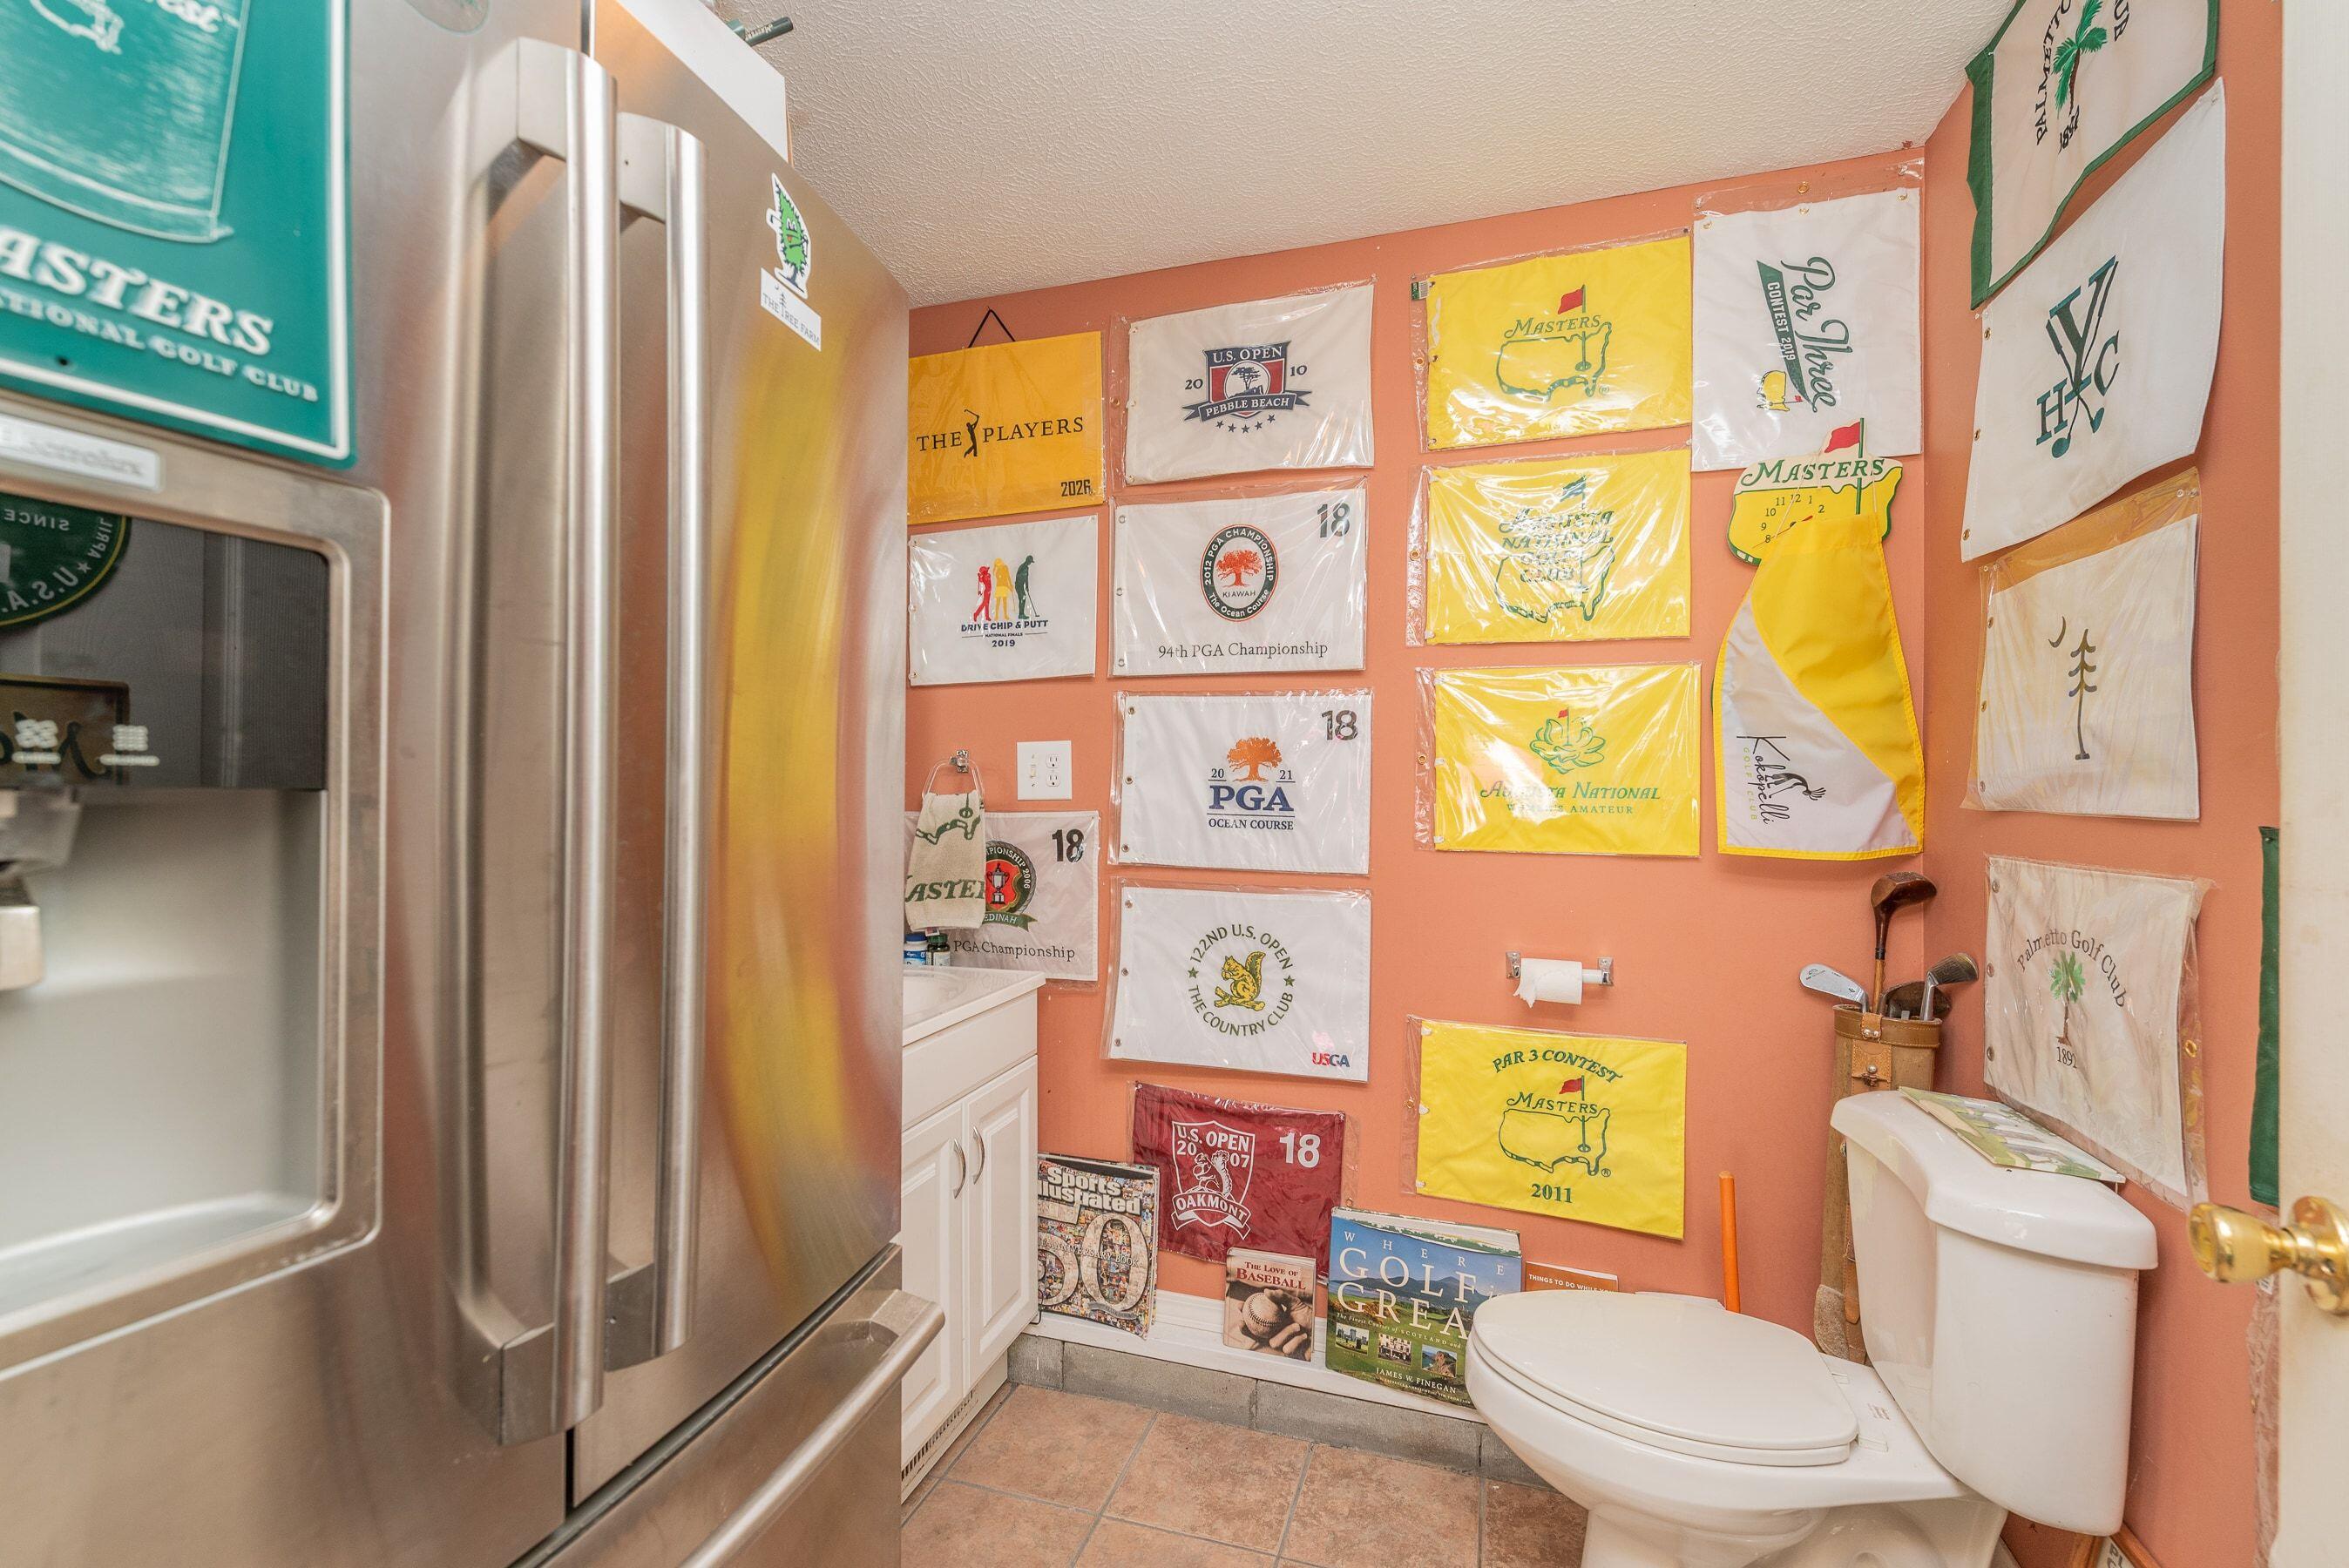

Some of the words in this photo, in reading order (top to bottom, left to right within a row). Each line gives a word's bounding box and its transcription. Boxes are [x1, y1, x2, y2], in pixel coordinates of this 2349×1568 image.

[2114, 0, 2129, 42] UB
[0, 225, 274, 356] ASTERS
[1780, 256, 1836, 321] Par
[801, 322, 820, 347] FARM
[1504, 314, 1601, 339] MASTERS
[1767, 281, 1790, 333] CONTEST
[1780, 337, 1797, 362] 2019
[0, 287, 146, 350] TIONAL
[146, 334, 238, 375] GOLF
[242, 362, 319, 402] CLUB
[1212, 350, 1236, 363] U.S.
[1239, 346, 1283, 360] OPEN
[1290, 365, 1308, 376] 10
[1794, 319, 1853, 413] Three
[1184, 378, 1204, 390] 20
[1206, 399, 1248, 417] PEBBLE
[1251, 397, 1290, 409] BEACH
[916, 431, 962, 452] THE
[982, 416, 1085, 443] PLAYERS
[1741, 458, 1885, 487] MASTERS
[1765, 508, 1777, 517] 10
[1818, 505, 1825, 514] 2
[1775, 497, 1785, 506] 11
[1791, 493, 1802, 504] 12
[1808, 496, 1812, 504] 1
[1317, 503, 1351, 538] 18
[1764, 534, 1771, 543] 8
[1208, 537, 1224, 558] PGA
[1225, 528, 1275, 581] CHAMPIONSHIP
[1208, 592, 1220, 608] The
[1221, 606, 1246, 617] Ocean
[1247, 589, 1269, 613] Course
[961, 623, 988, 632] DRIVE
[1024, 619, 1049, 628] PUTT
[1158, 645, 1188, 659] 94th
[1191, 645, 1224, 657] PGA
[1228, 641, 1328, 659] Championship
[1321, 709, 1358, 741] 18
[1210, 768, 1225, 779] 20
[1279, 770, 1292, 780] 21
[1208, 785, 1295, 812] PGA
[1479, 781, 1567, 799] AUTA
[1571, 781, 1661, 801] NATIONAL
[1570, 805, 1634, 814] AMATEUR
[1208, 818, 1247, 828] OCEAN
[1249, 819, 1294, 830] COURSE
[1051, 828, 1085, 862] 18
[986, 846, 1026, 868] PIONSHIP
[1022, 868, 1032, 889] 2006
[905, 875, 985, 902] ASTE
[985, 913, 1018, 924] EDINAH
[953, 940, 982, 953] PGA
[981, 943, 1076, 963] Championship
[1190, 926, 1228, 963] 122ND
[1231, 924, 1256, 940] U.S.
[1260, 933, 1294, 970] OPEN
[2017, 929, 2068, 973] Palmetto
[2071, 929, 2104, 961] Golf
[2101, 954, 2128, 1007] Club
[1188, 984, 1207, 1014] THE
[1202, 1010, 1266, 1037] COUNTRY
[1267, 991, 1294, 1026] CLUB
[1312, 1051, 1351, 1068] USGA
[1492, 1051, 1525, 1073] PAR
[1528, 1049, 1539, 1061] 3
[1541, 1049, 1623, 1084] CONTEST
[1506, 1092, 1598, 1114] MASTERS
[1176, 1125, 1203, 1145] U.S.
[1205, 1131, 1250, 1152] OPEN
[1176, 1140, 1197, 1156] 20
[1279, 1132, 1322, 1168] 18
[1229, 1152, 1250, 1169] 07
[1047, 1166, 1121, 1196] Sports
[1531, 1183, 1573, 1204] 2011
[1038, 1179, 1142, 1215] llustrated
[1175, 1193, 1249, 1223] OAKMONT
[1344, 1231, 1506, 1276] WHERE
[1236, 1267, 1307, 1289] BASEBALL
[1245, 1261, 1262, 1270] THE
[1264, 1265, 1285, 1274] LOVE
[1339, 1247, 1478, 1303] GOLF
[1528, 1274, 1554, 1284] THINGS
[1337, 1281, 1468, 1341] GREA
[1400, 1328, 1447, 1346] SCOTLAND
[1376, 1368, 1403, 1380] JAMES
[1416, 1377, 1457, 1394] FINEGAN
